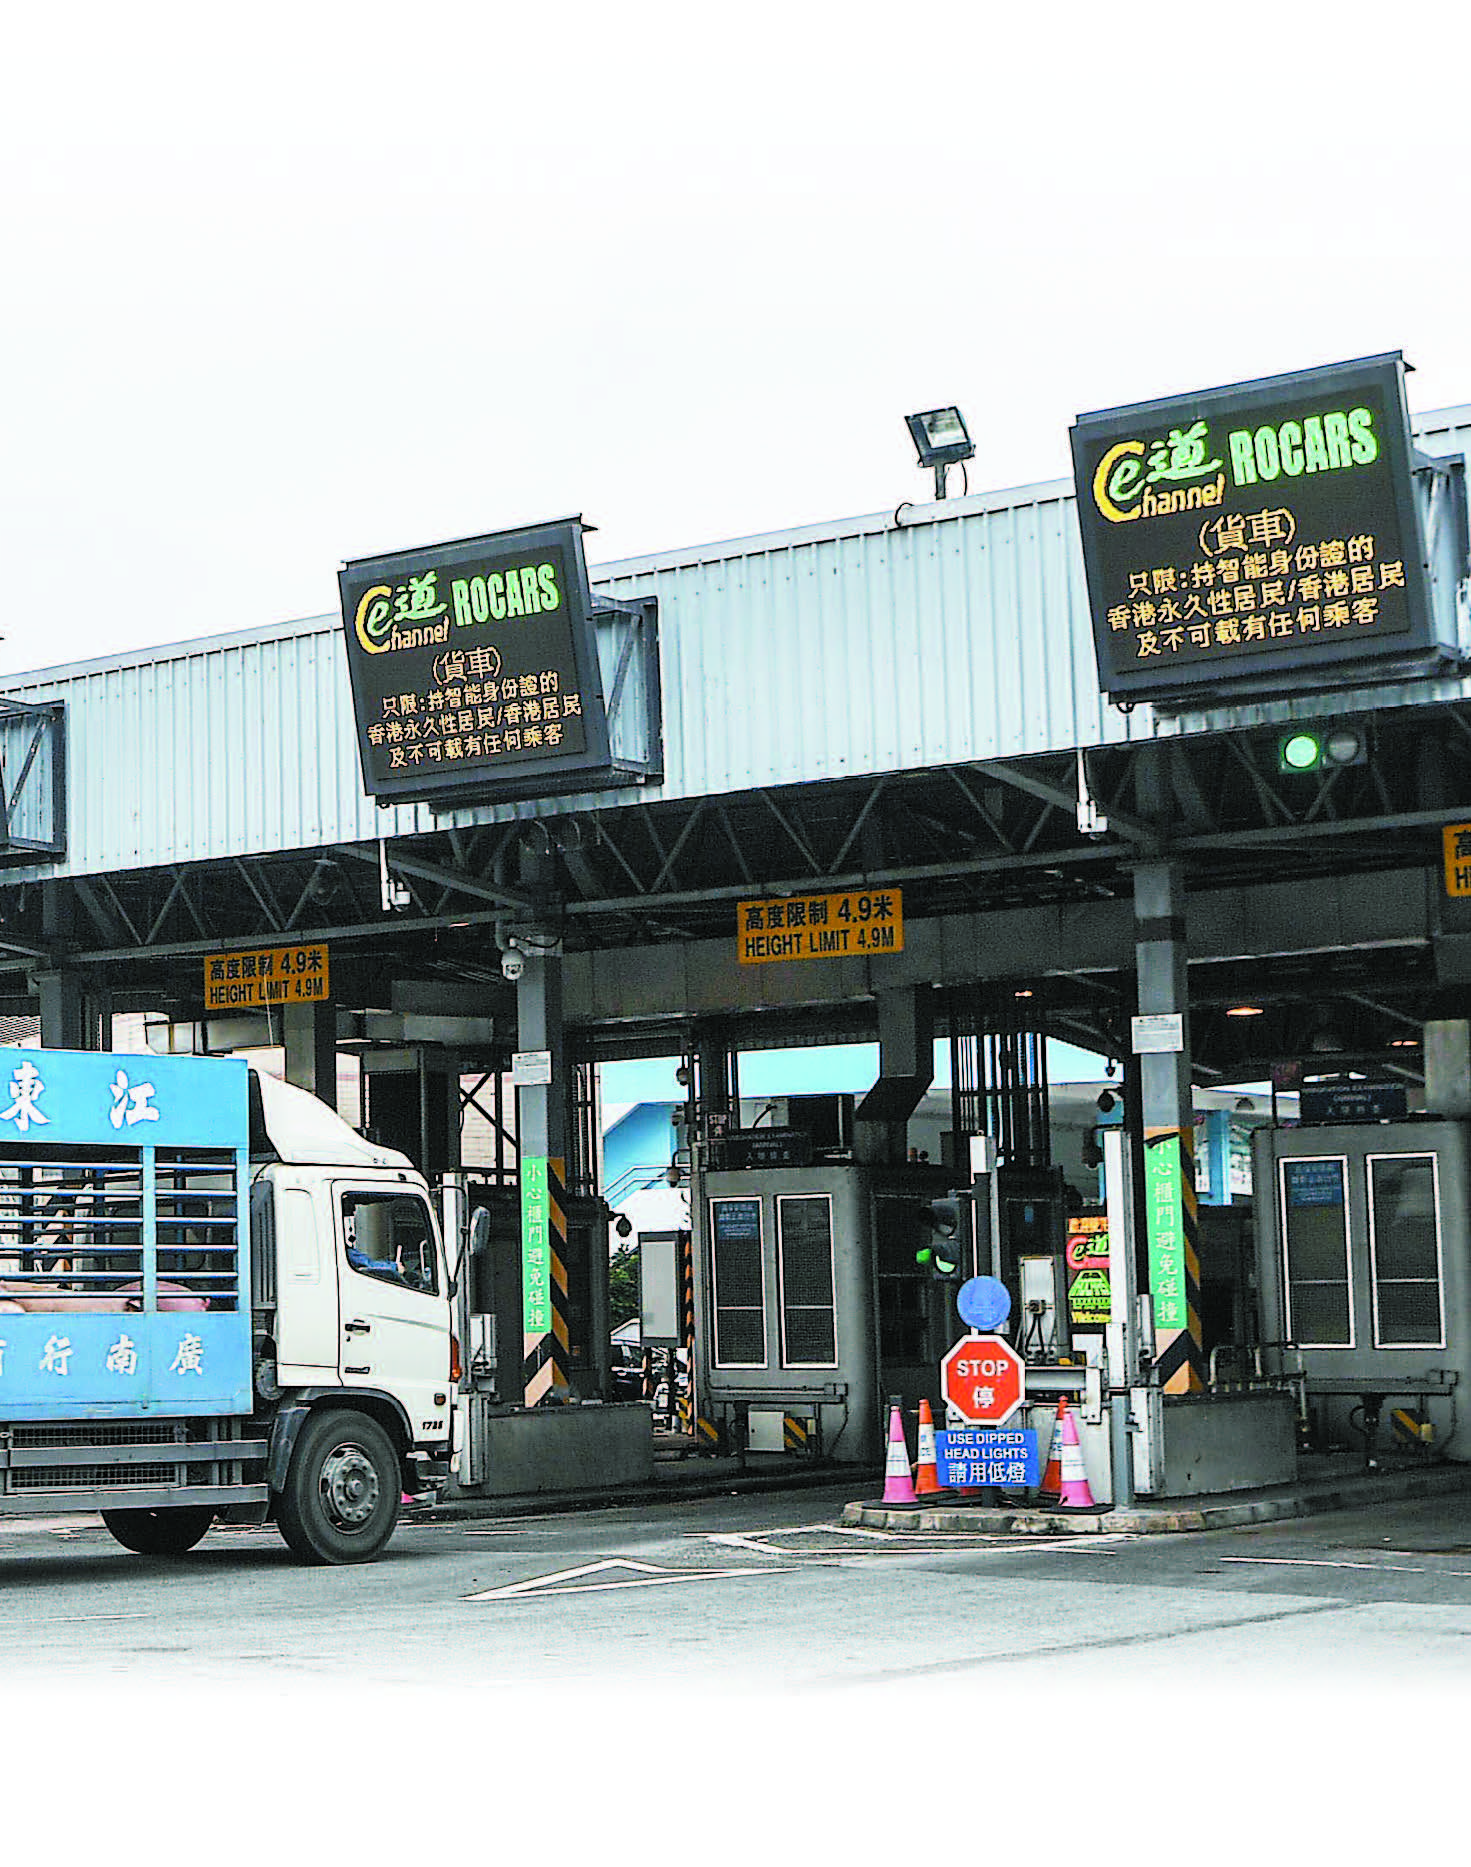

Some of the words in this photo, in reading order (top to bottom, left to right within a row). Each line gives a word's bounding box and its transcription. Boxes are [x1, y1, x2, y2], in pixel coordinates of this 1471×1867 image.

[1229, 408, 1378, 486] ROCARS
[452, 563, 559, 627] ROCARS
[1137, 598, 1379, 658] 及不可載有任何乘客
[389, 723, 564, 768] 及不可載有任何乘客
[745, 899, 827, 931] 高度限制
[838, 894, 894, 923] 4.9米
[745, 933, 803, 957] HEIGHT
[809, 929, 850, 953] LIMIT
[857, 926, 894, 949] 4.9M
[280, 949, 323, 974] 4.9米
[210, 983, 254, 1004] HEIGHT
[258, 980, 290, 1000] LIMIT
[295, 977, 324, 997] 4.9M
[957, 1359, 1009, 1377] STOP
[972, 1386, 995, 1409] 停
[947, 1433, 974, 1445] USE
[975, 1432, 1025, 1445] DIPPED
[944, 1448, 980, 1459] HEAD
[981, 1447, 1029, 1459] LIGHTS
[948, 1461, 1027, 1484] 請用低燈
